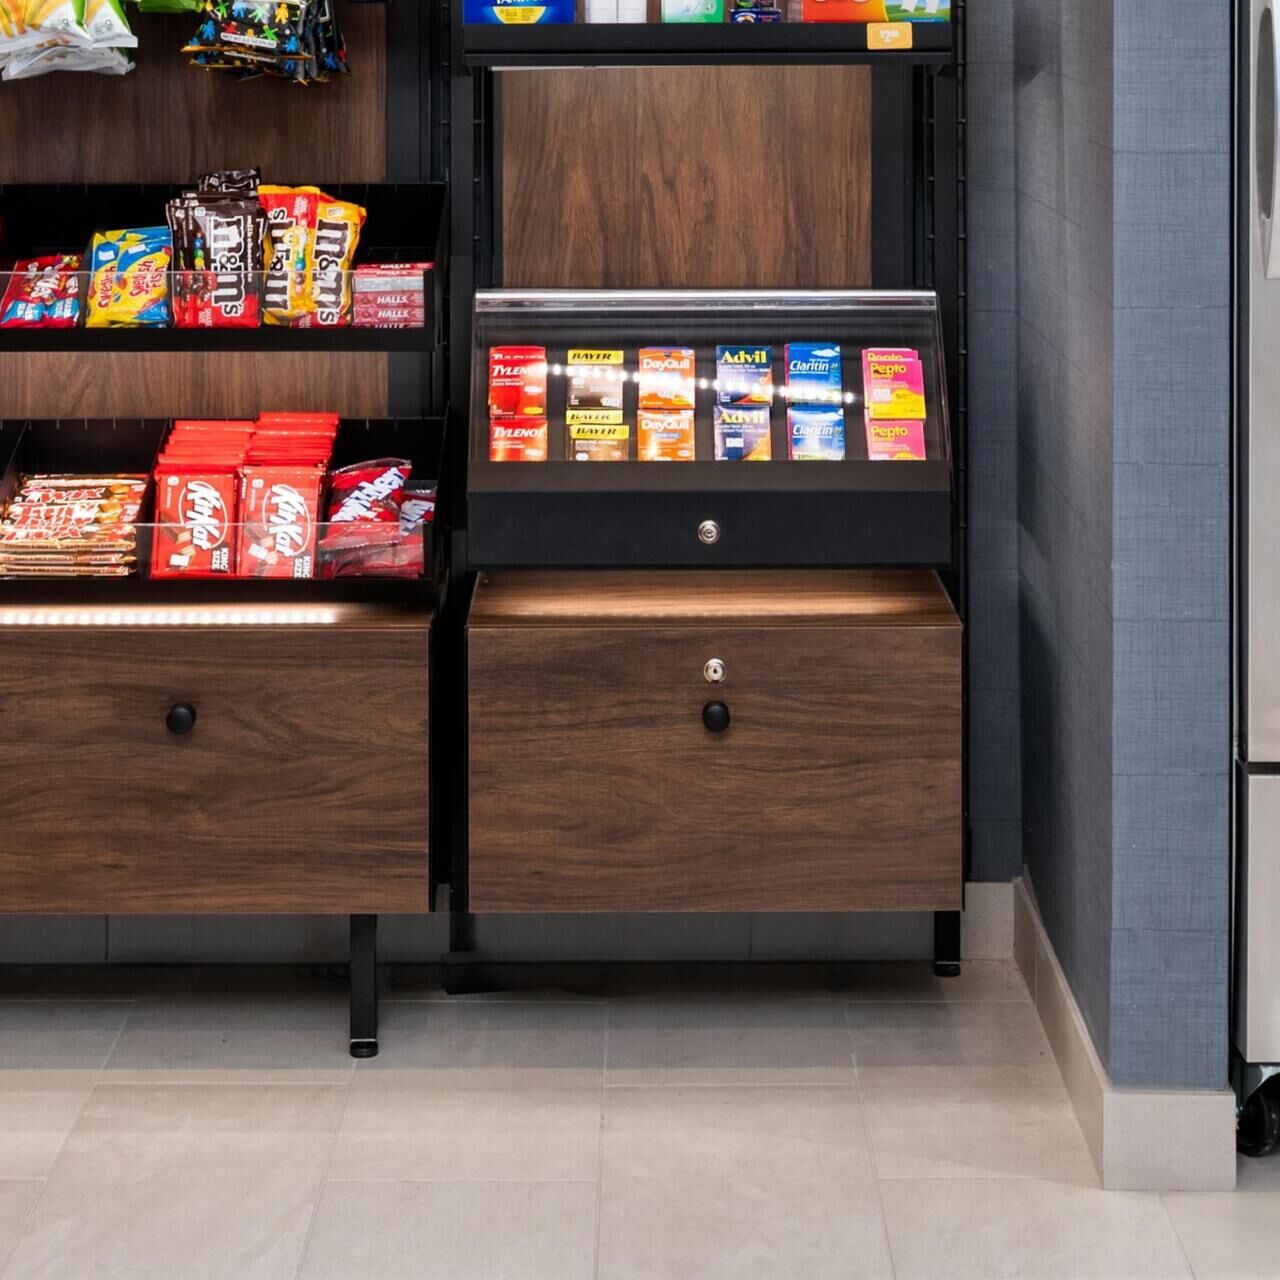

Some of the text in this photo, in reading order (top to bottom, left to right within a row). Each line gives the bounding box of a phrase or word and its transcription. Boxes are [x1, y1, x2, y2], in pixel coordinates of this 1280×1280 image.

[377, 296, 408, 304] HALLS
[378, 310, 409, 318] HALLS
[720, 351, 767, 364] Advil
[643, 359, 690, 371] DayQuil
[790, 360, 829, 371] Claritin
[871, 363, 907, 375] Pepto
[719, 411, 765, 423] Advil
[642, 420, 689, 432] DayQuil
[793, 424, 832, 435] Claritin
[872, 426, 908, 438] Pepto
[220, 547, 229, 570] KING
